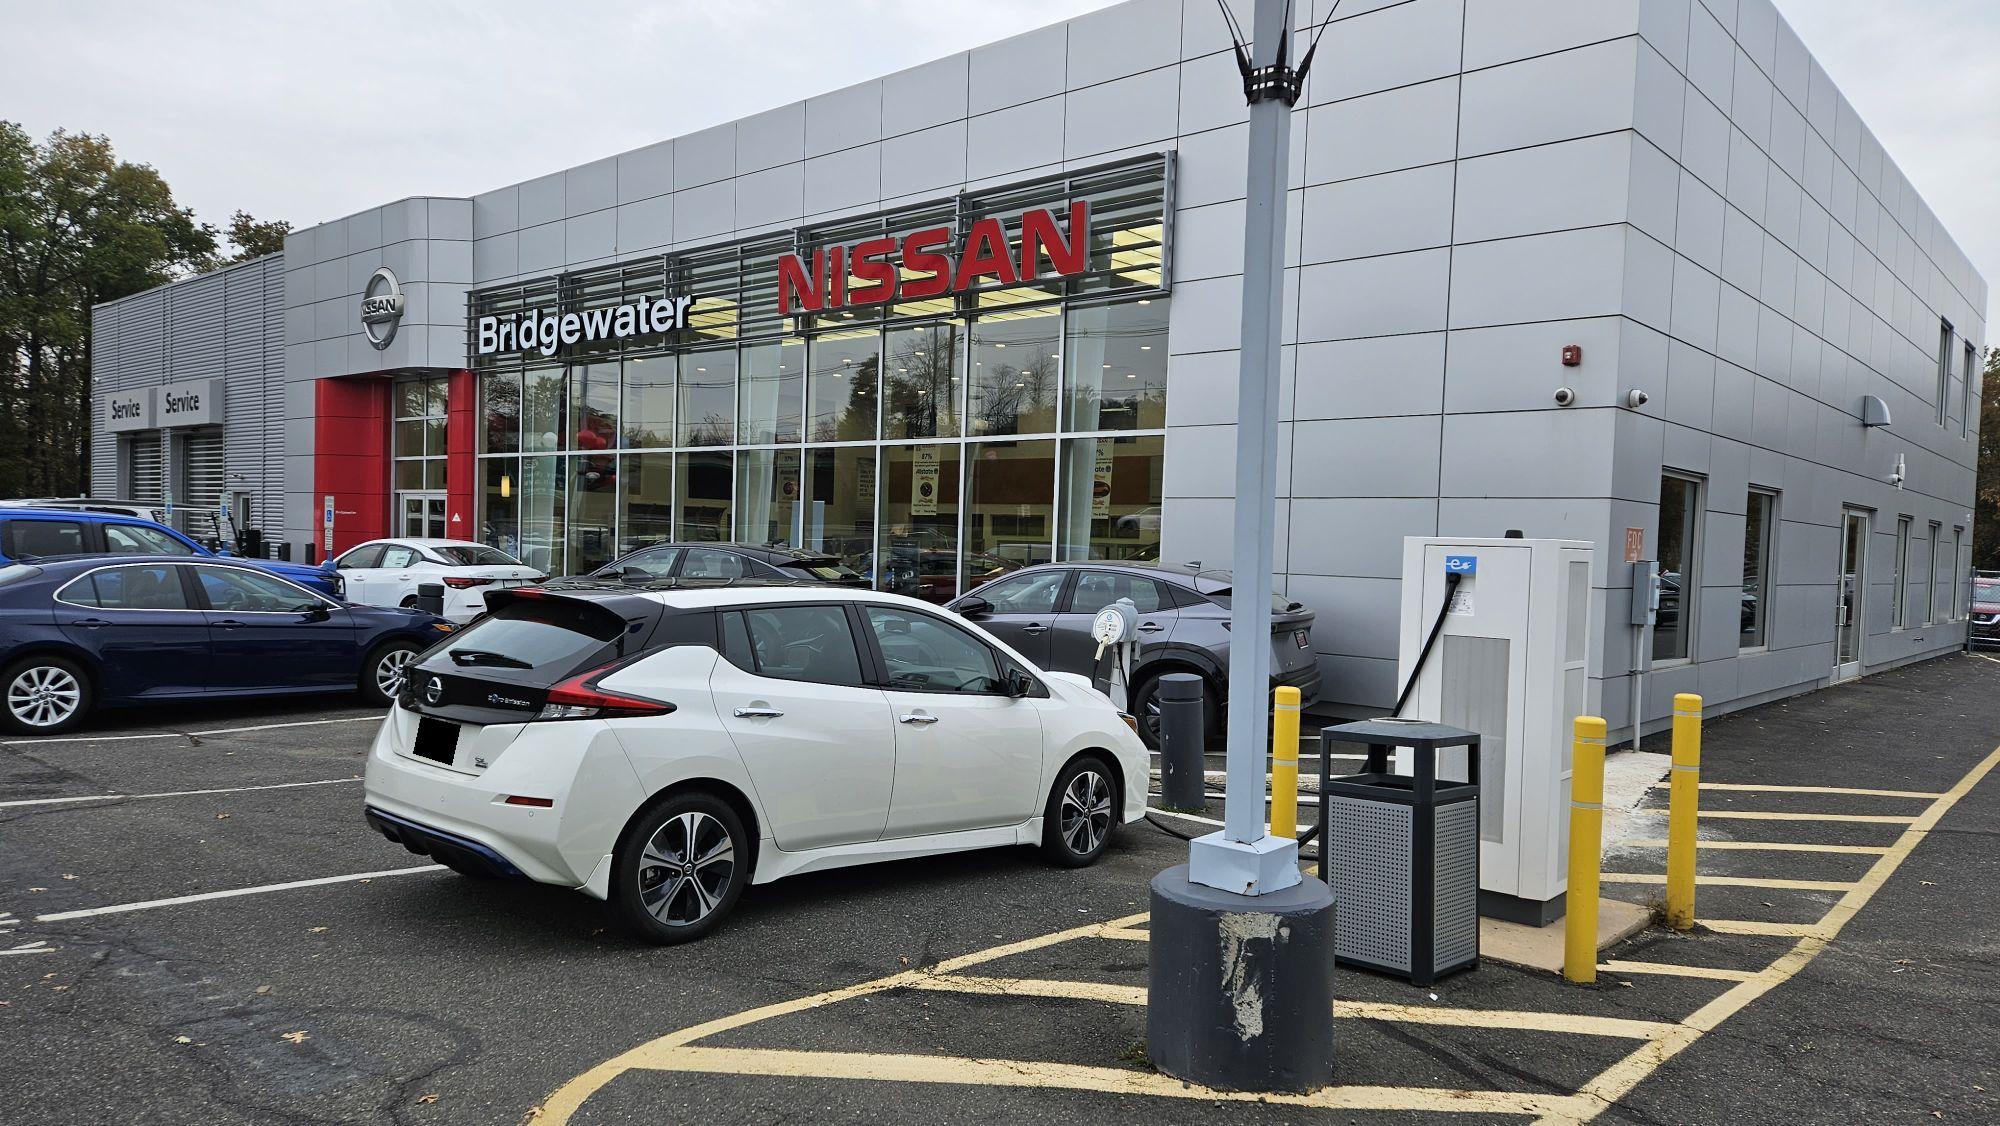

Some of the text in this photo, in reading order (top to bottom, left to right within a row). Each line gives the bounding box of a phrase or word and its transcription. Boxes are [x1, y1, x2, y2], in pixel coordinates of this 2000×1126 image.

[778, 200, 1088, 314] NISSAN
[479, 295, 692, 356] Bridgewater
[112, 398, 140, 419] Service
[166, 390, 199, 414] Service
[1627, 530, 1642, 550] FDC
